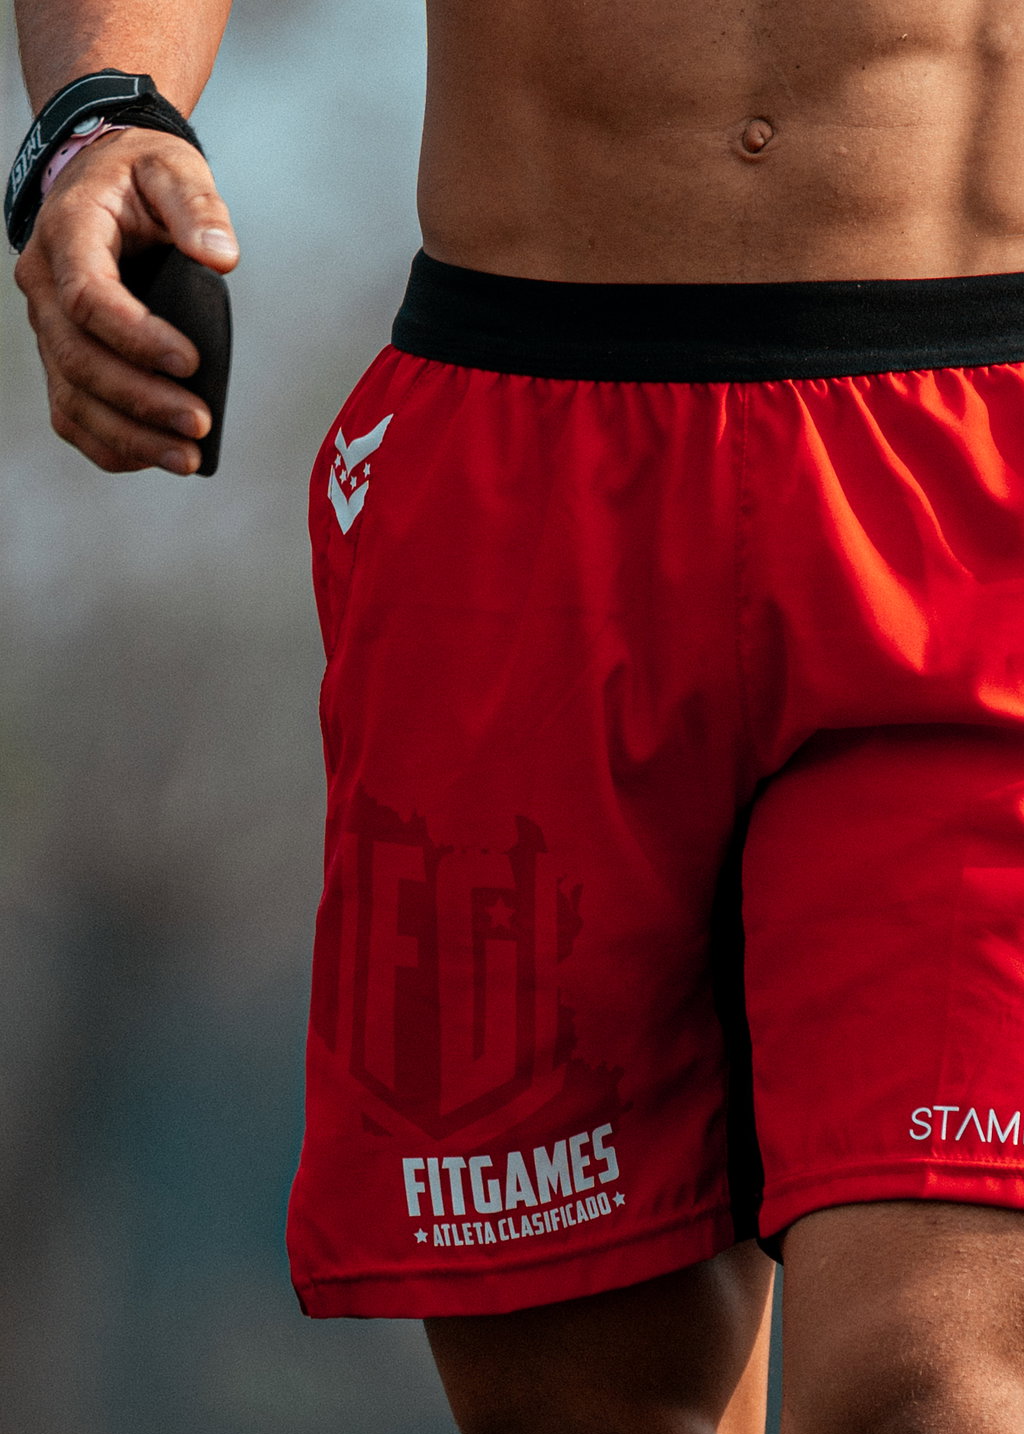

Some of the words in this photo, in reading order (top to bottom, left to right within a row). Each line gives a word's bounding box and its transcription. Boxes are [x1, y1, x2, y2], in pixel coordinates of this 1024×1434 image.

[402, 1123, 619, 1217] FITGAMES
[433, 1221, 497, 1246] ATLETA
[498, 1192, 612, 1241] CLASIFICADO
